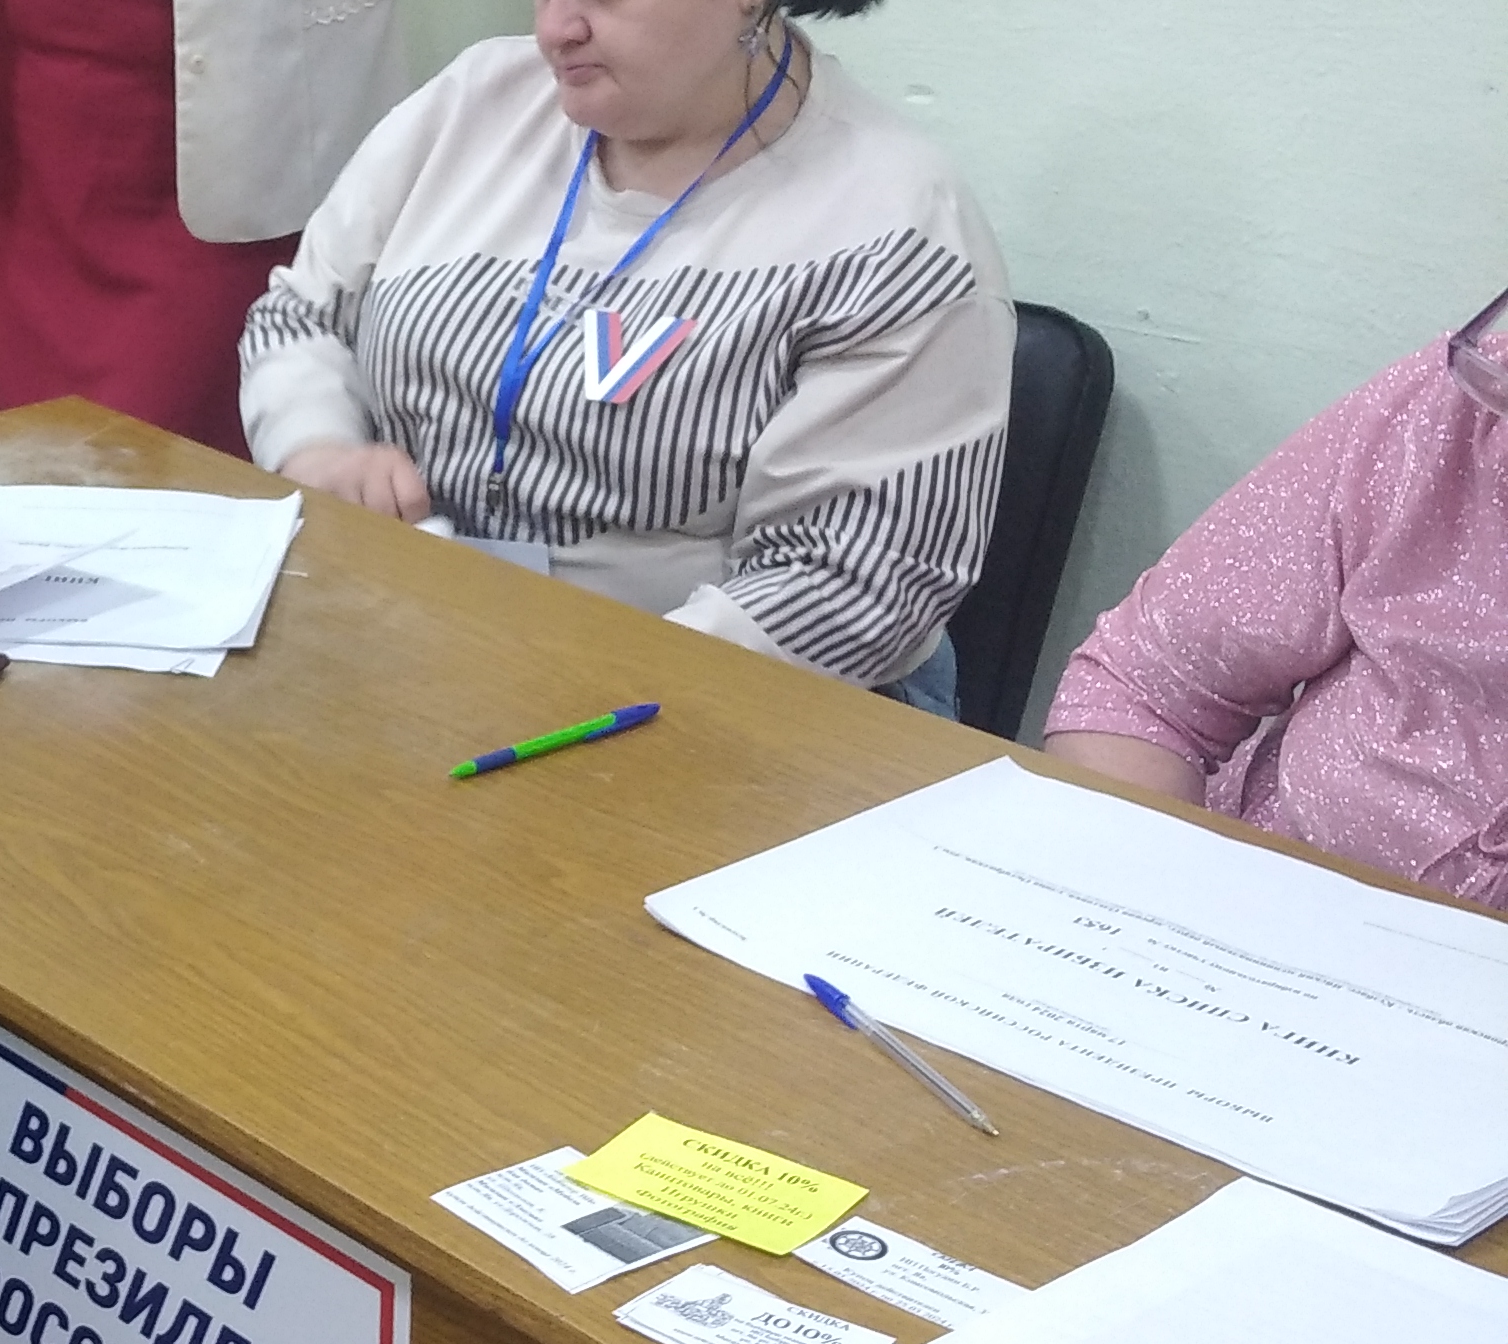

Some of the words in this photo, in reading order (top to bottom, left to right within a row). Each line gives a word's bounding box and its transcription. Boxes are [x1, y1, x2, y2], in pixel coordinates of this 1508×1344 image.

[935, 907, 1125, 979] ИЗБИРАТЕЛЕЙ
[1072, 916, 1122, 936] 1653
[826, 950, 928, 991] ФЕДЕРАЦИИ
[930, 989, 1053, 1041] РОССИЙСКОЙ
[1134, 978, 1250, 1023] СПИСКА
[1058, 1039, 1177, 1089] ПРЕЗИДЕНТА
[1261, 1021, 1360, 1065] КНИГА
[1186, 1089, 1274, 1123] ВЫБОРЫ
[682, 1139, 770, 1176] СКИДКА
[777, 1172, 818, 1193] 10%
[701, 1161, 722, 1173] на
[714, 1182, 735, 1191] до
[10, 1099, 276, 1311] ВЫБОРЫ
[633, 1162, 735, 1207] Канцтовары,
[741, 1204, 794, 1227] книги
[660, 1185, 738, 1219] Игрушки
[750, 1311, 792, 1329] ДО
[786, 1303, 850, 1332] СКИДКА
